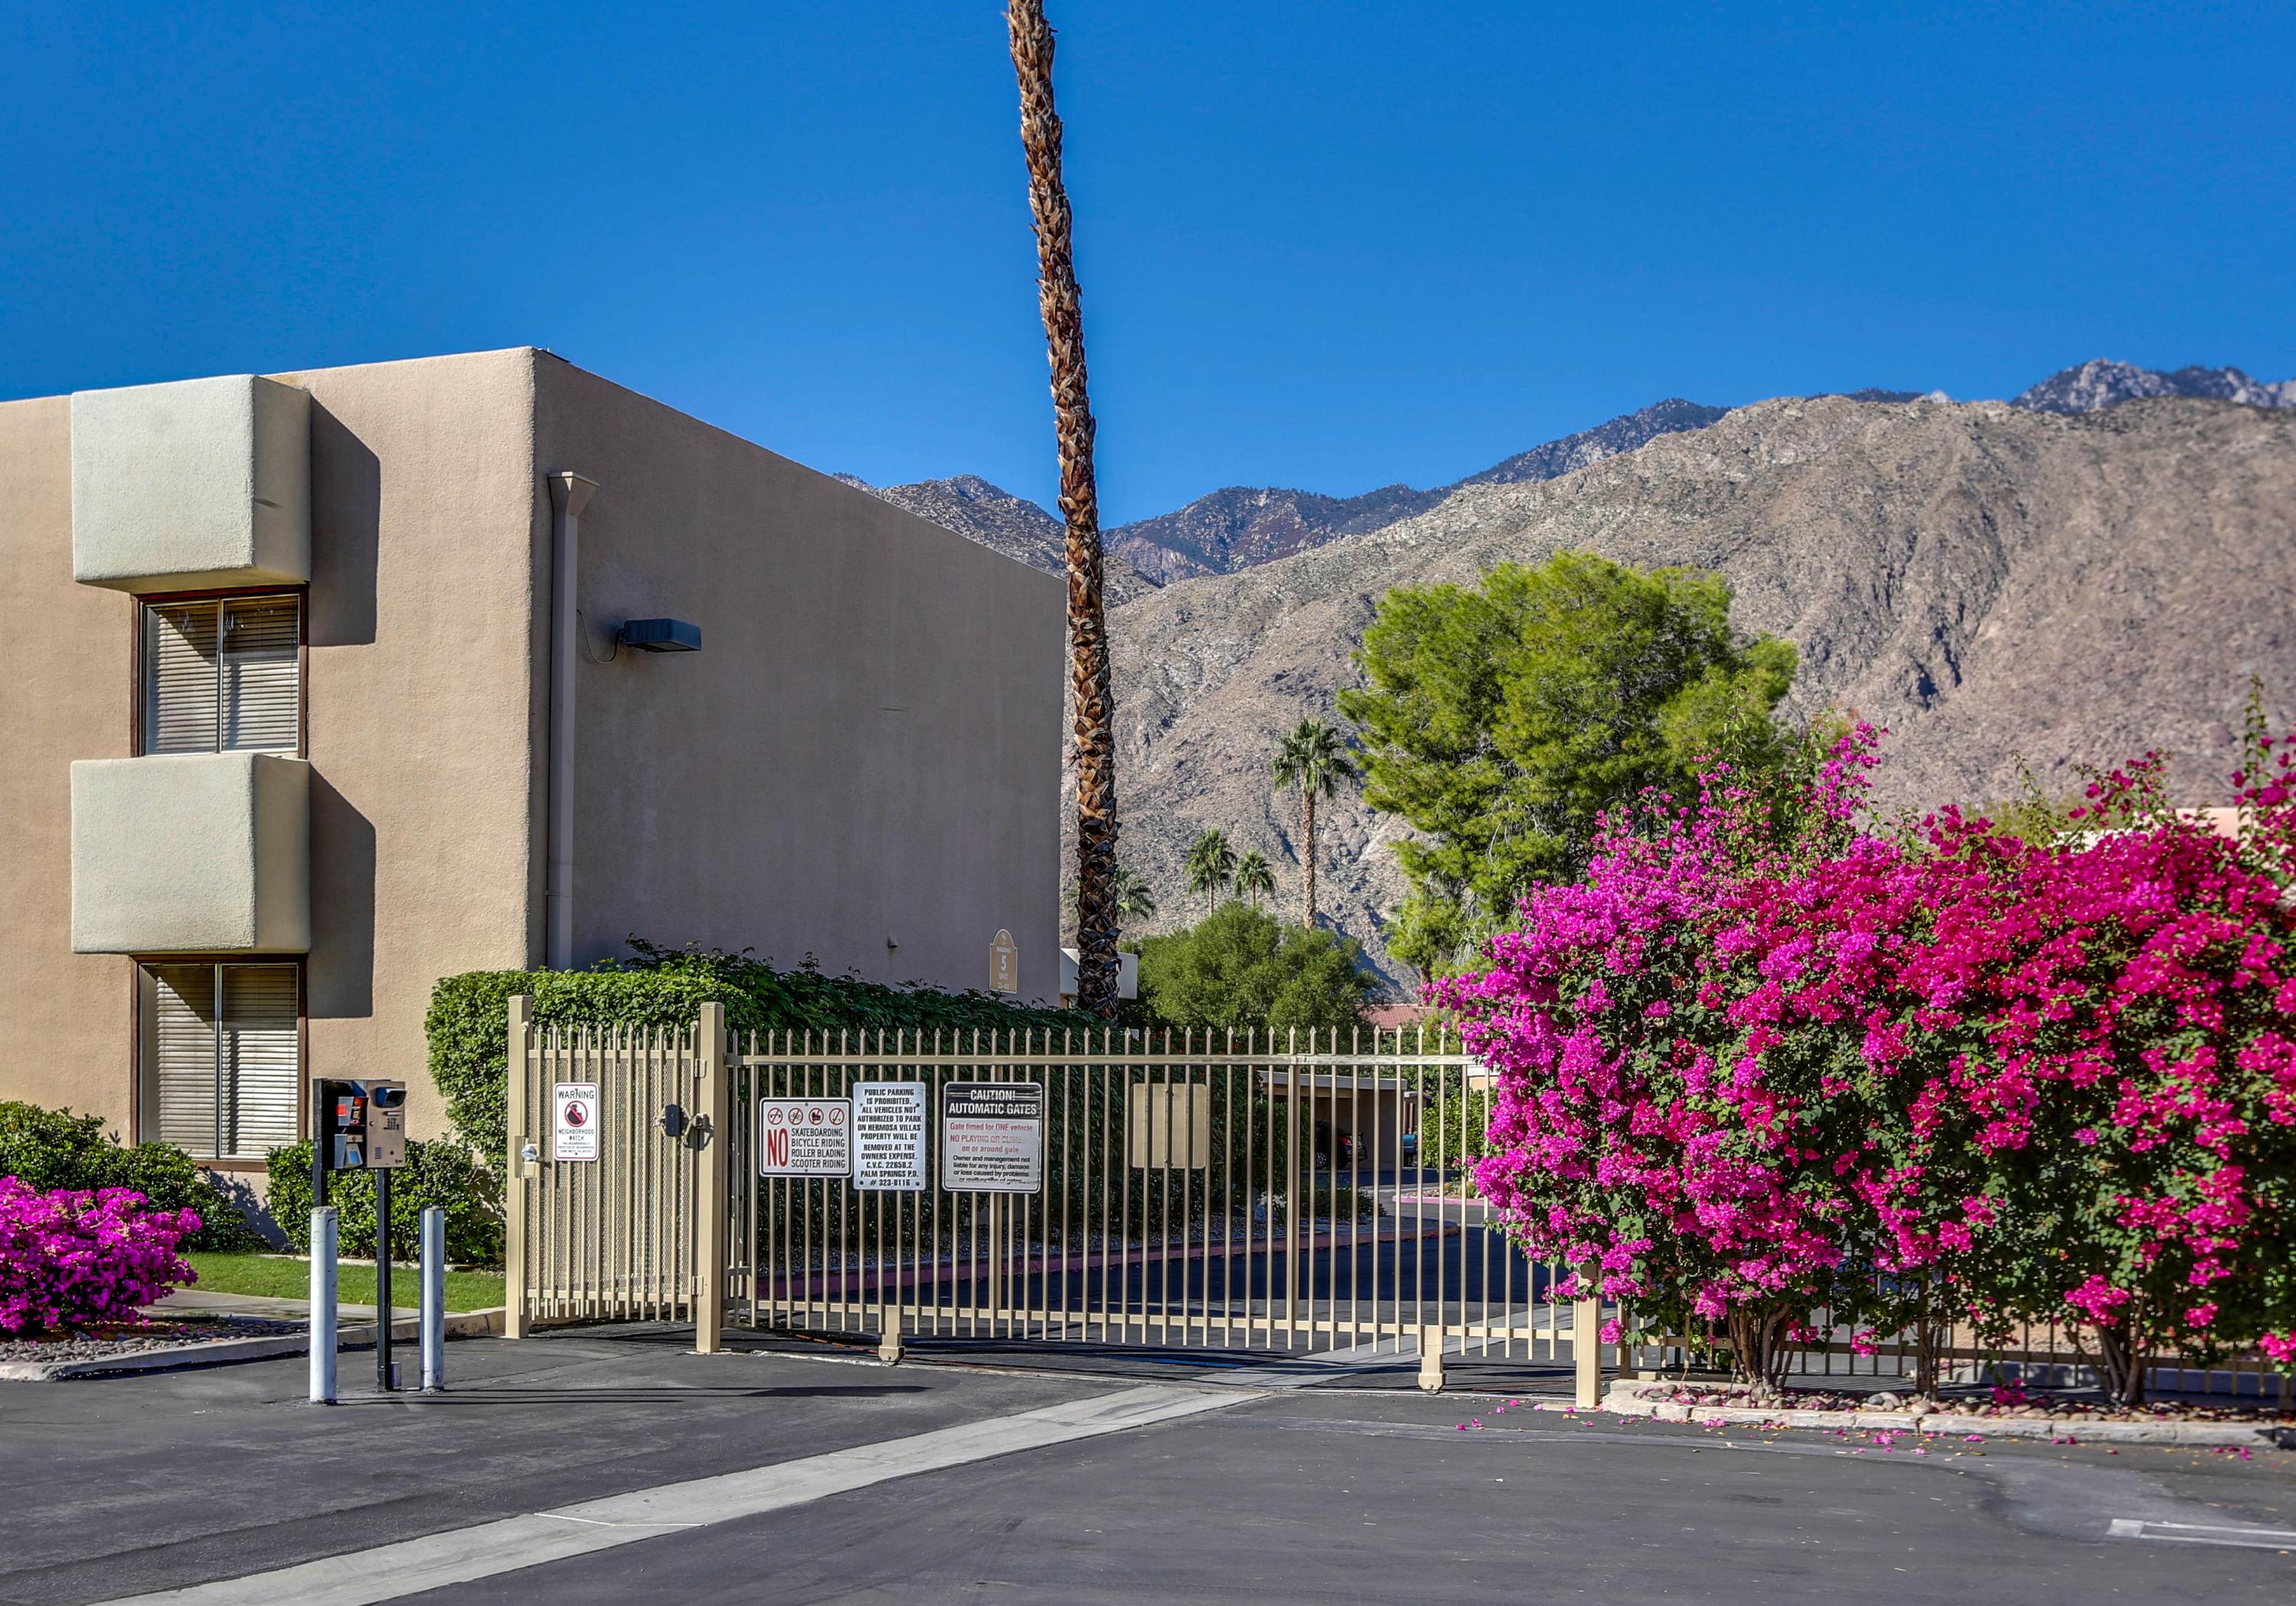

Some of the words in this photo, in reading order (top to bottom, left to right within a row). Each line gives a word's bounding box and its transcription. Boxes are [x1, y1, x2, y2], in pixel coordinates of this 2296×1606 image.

[1000, 955, 1007, 971] 5
[558, 1090, 595, 1099] WARNING
[970, 1090, 1016, 1101] CAUTION!
[949, 1103, 1004, 1114] AUTOMATIC
[1006, 1103, 1037, 1115] GATES
[791, 1128, 843, 1137] SKATEBOARDING
[768, 1128, 788, 1167] NO
[791, 1139, 819, 1147] BICYCLE
[821, 1139, 845, 1148] RIDING
[791, 1148, 816, 1158] ROLLER
[817, 1148, 846, 1158] BLADING
[791, 1159, 821, 1168] SCOOTER
[823, 1159, 846, 1168] RIDING
